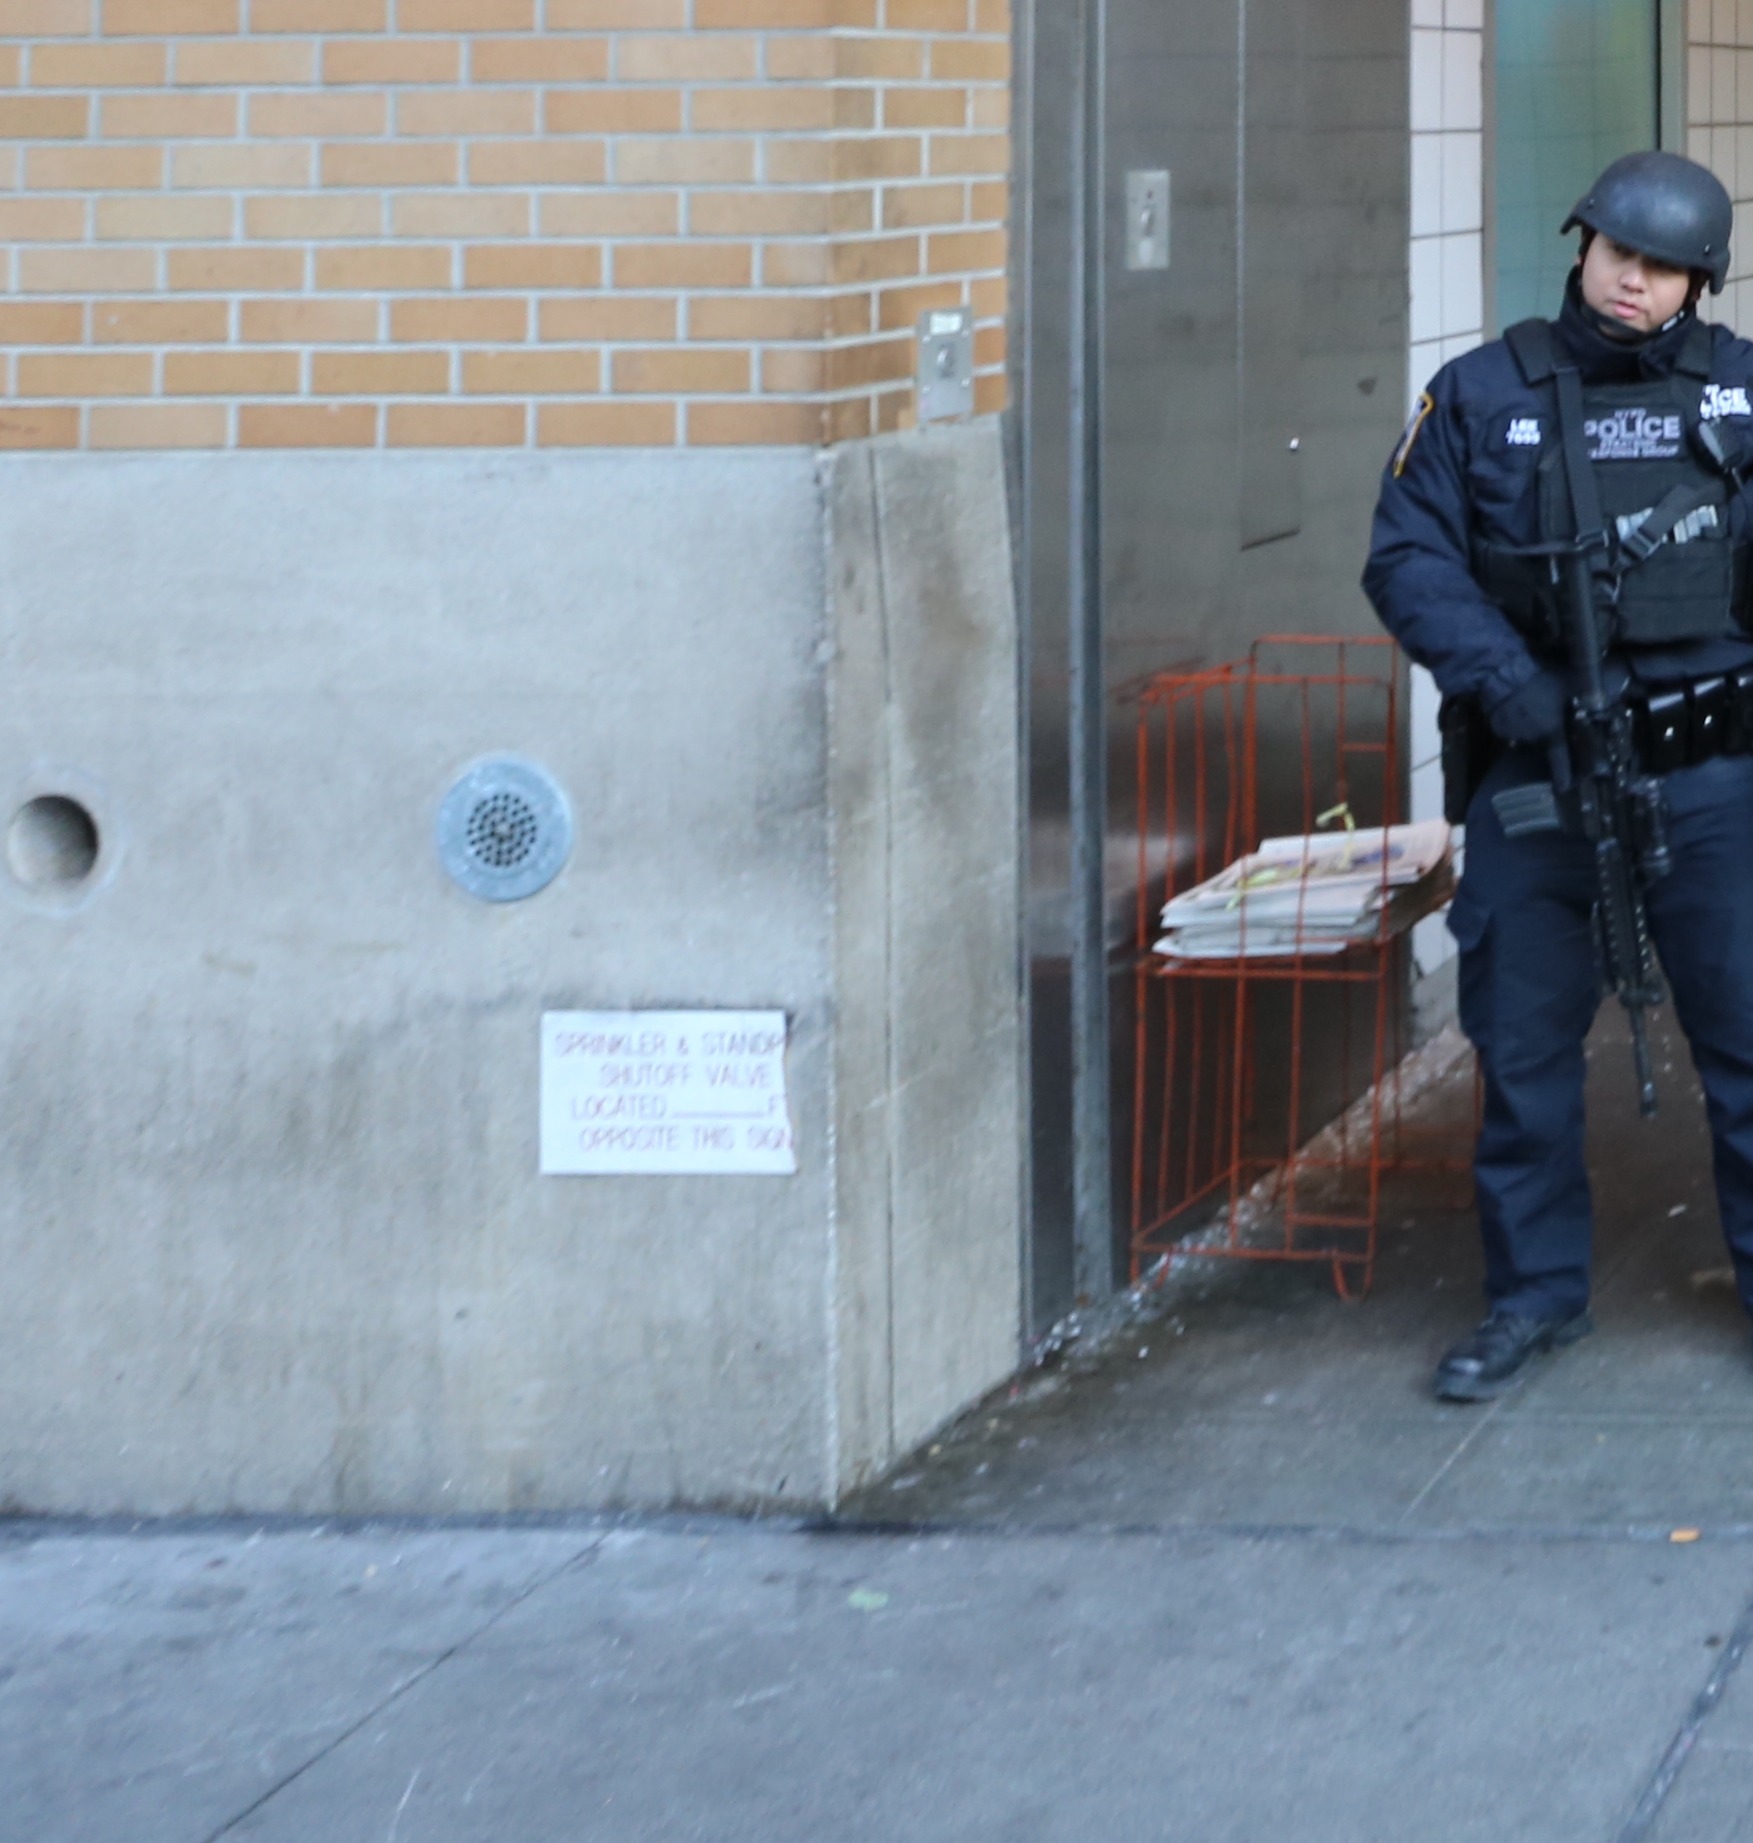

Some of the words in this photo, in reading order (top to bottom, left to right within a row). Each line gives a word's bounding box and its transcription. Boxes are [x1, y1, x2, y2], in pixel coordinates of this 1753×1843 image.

[1583, 415, 1681, 440] POLICE
[555, 1032, 667, 1057] SPRINKLER
[676, 1035, 690, 1056] &
[599, 1063, 692, 1089] SHUTOFF
[705, 1063, 772, 1089] VALVE
[570, 1094, 668, 1120] LOCATED
[578, 1125, 680, 1151] OPPOSITE
[692, 1125, 735, 1151] THIS
